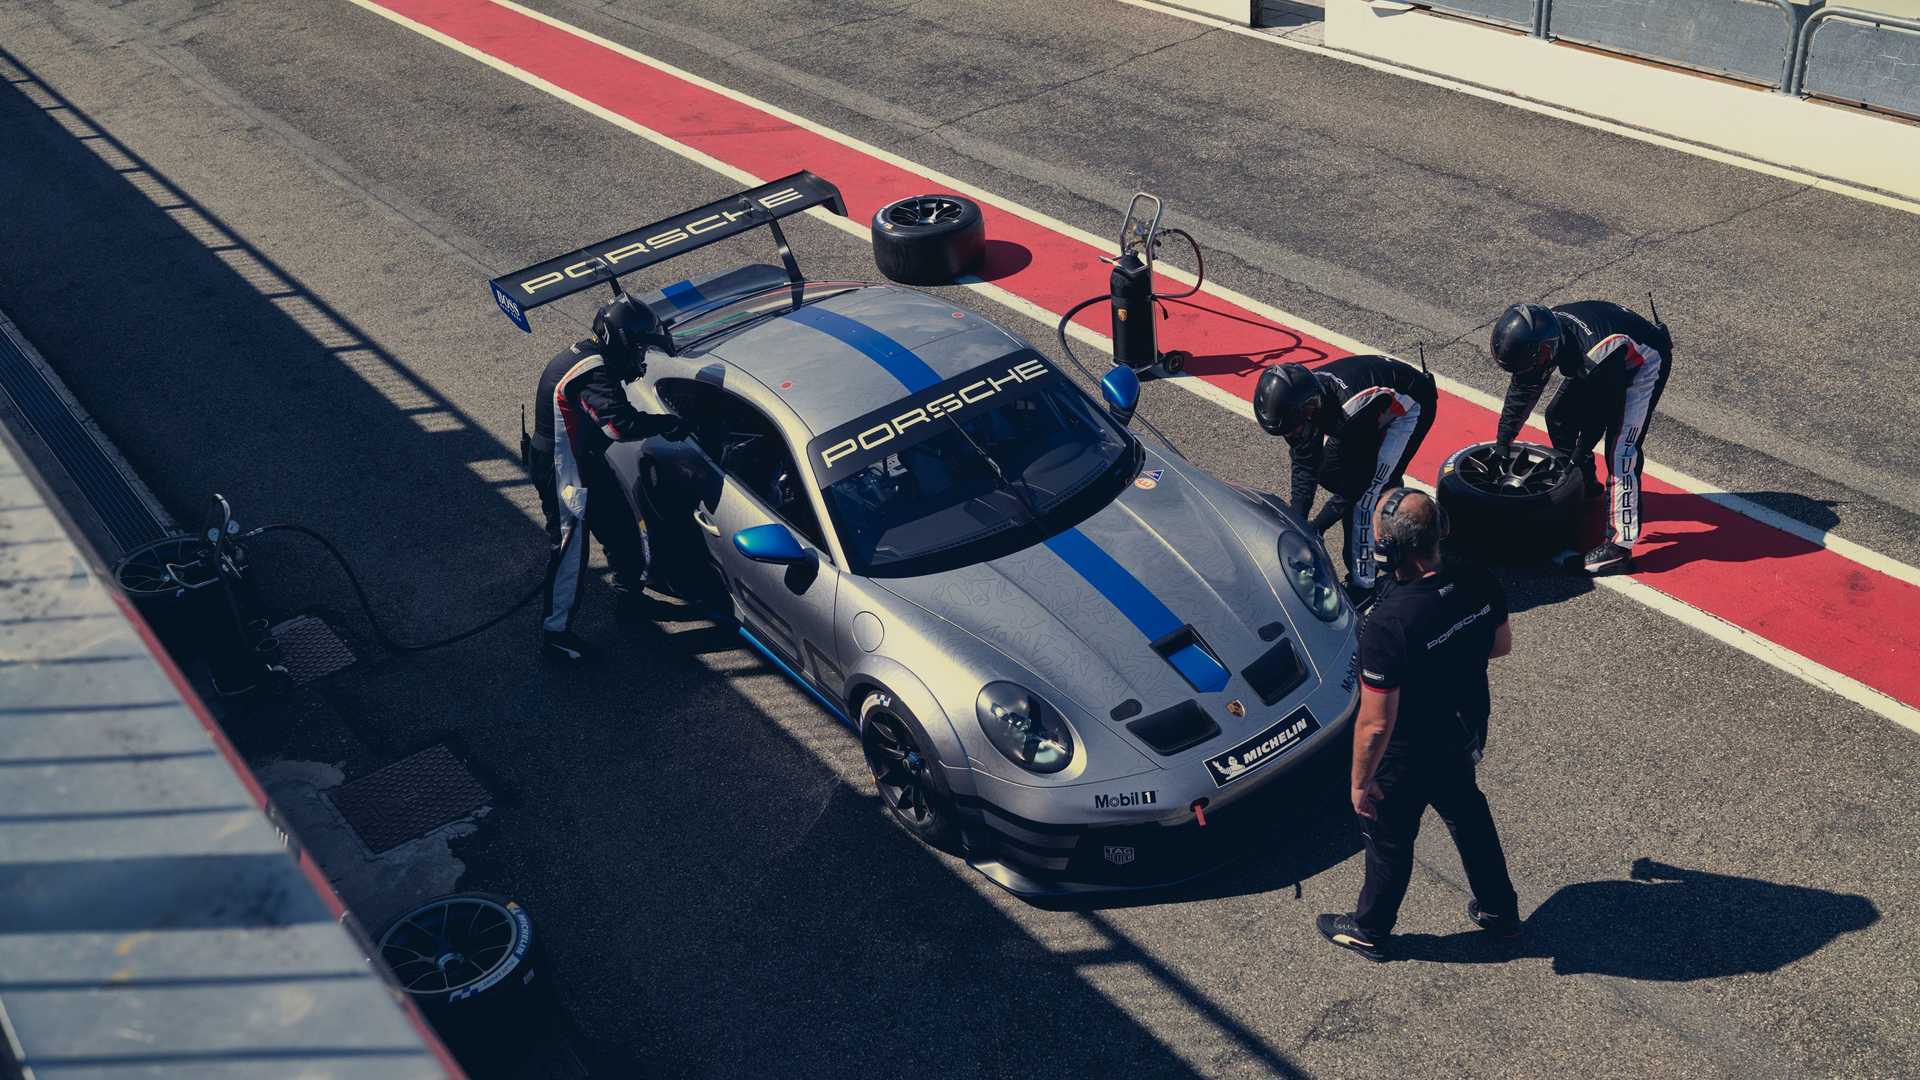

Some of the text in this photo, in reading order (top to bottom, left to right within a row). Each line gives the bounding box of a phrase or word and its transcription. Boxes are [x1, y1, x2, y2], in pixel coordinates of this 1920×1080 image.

[821, 359, 1049, 469] PORSCHE
[1360, 463, 1390, 577] PORSCHE
[1622, 427, 1639, 542] PORSCHE
[1427, 603, 1491, 650] PORSCHE
[1243, 718, 1308, 764] MICHELIN
[1095, 792, 1139, 808] Mobil
